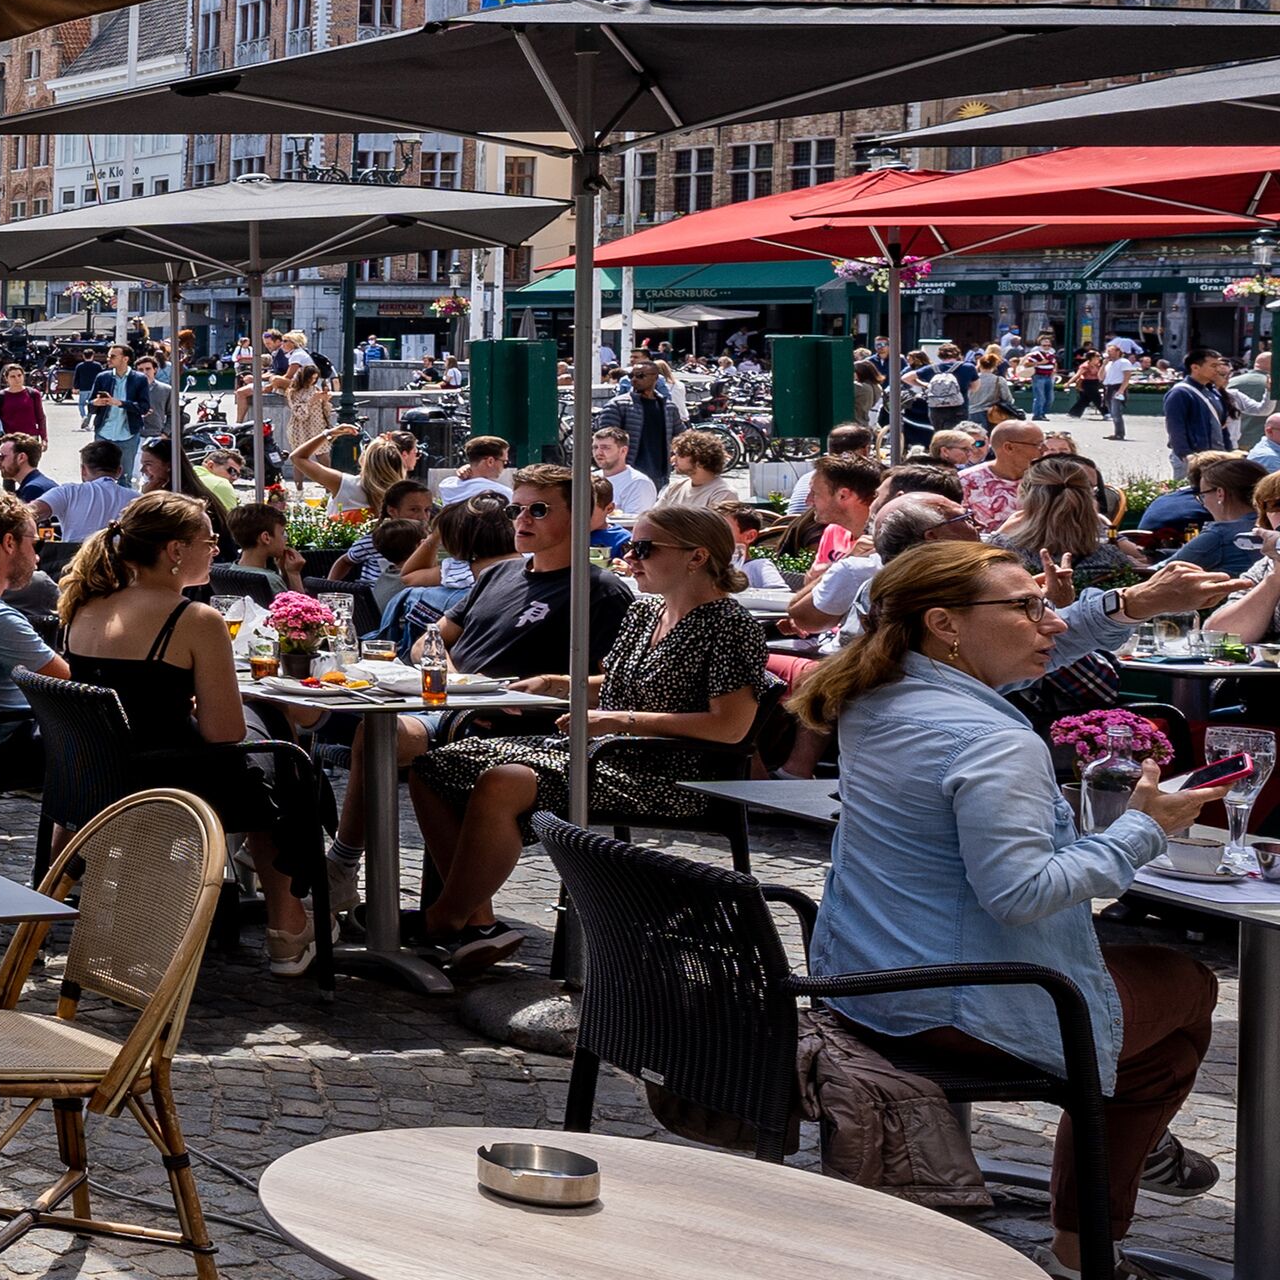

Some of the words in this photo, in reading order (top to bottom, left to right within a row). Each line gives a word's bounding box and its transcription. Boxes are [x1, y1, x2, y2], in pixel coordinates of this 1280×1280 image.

[109, 166, 140, 178] Kloe
[899, 287, 945, 295] rand-Café
[998, 281, 1049, 293] Huyze
[1053, 280, 1082, 291] Die
[1086, 280, 1142, 291] Maene
